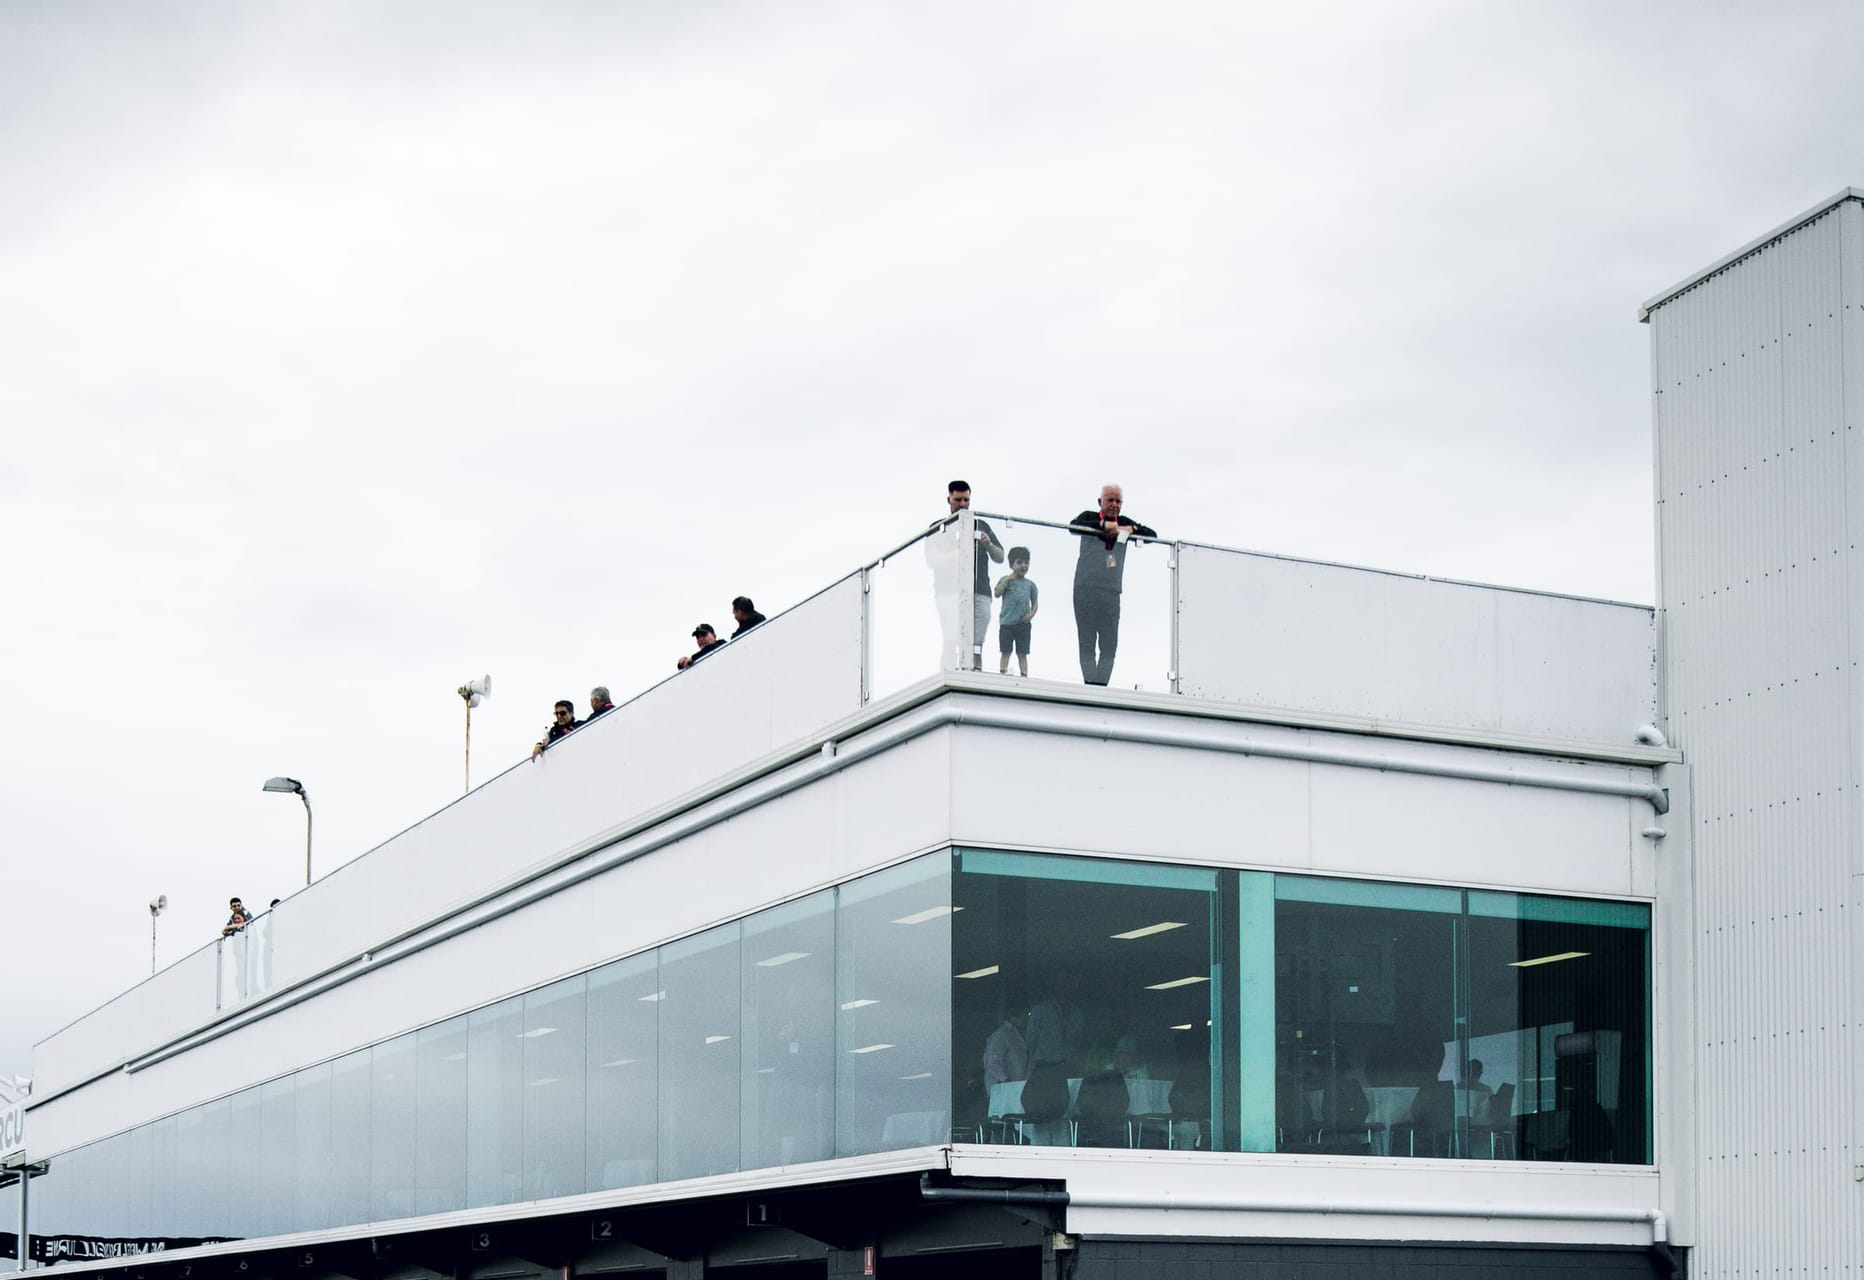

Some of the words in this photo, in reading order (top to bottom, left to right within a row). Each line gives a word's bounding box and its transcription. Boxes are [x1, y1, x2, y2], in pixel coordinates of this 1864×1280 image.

[759, 1205, 767, 1222] 1
[601, 1222, 612, 1236] 2
[480, 1233, 490, 1247] 3
[304, 1253, 313, 1264] 5
[185, 1266, 192, 1276] 7
[240, 1260, 248, 1270] 6
